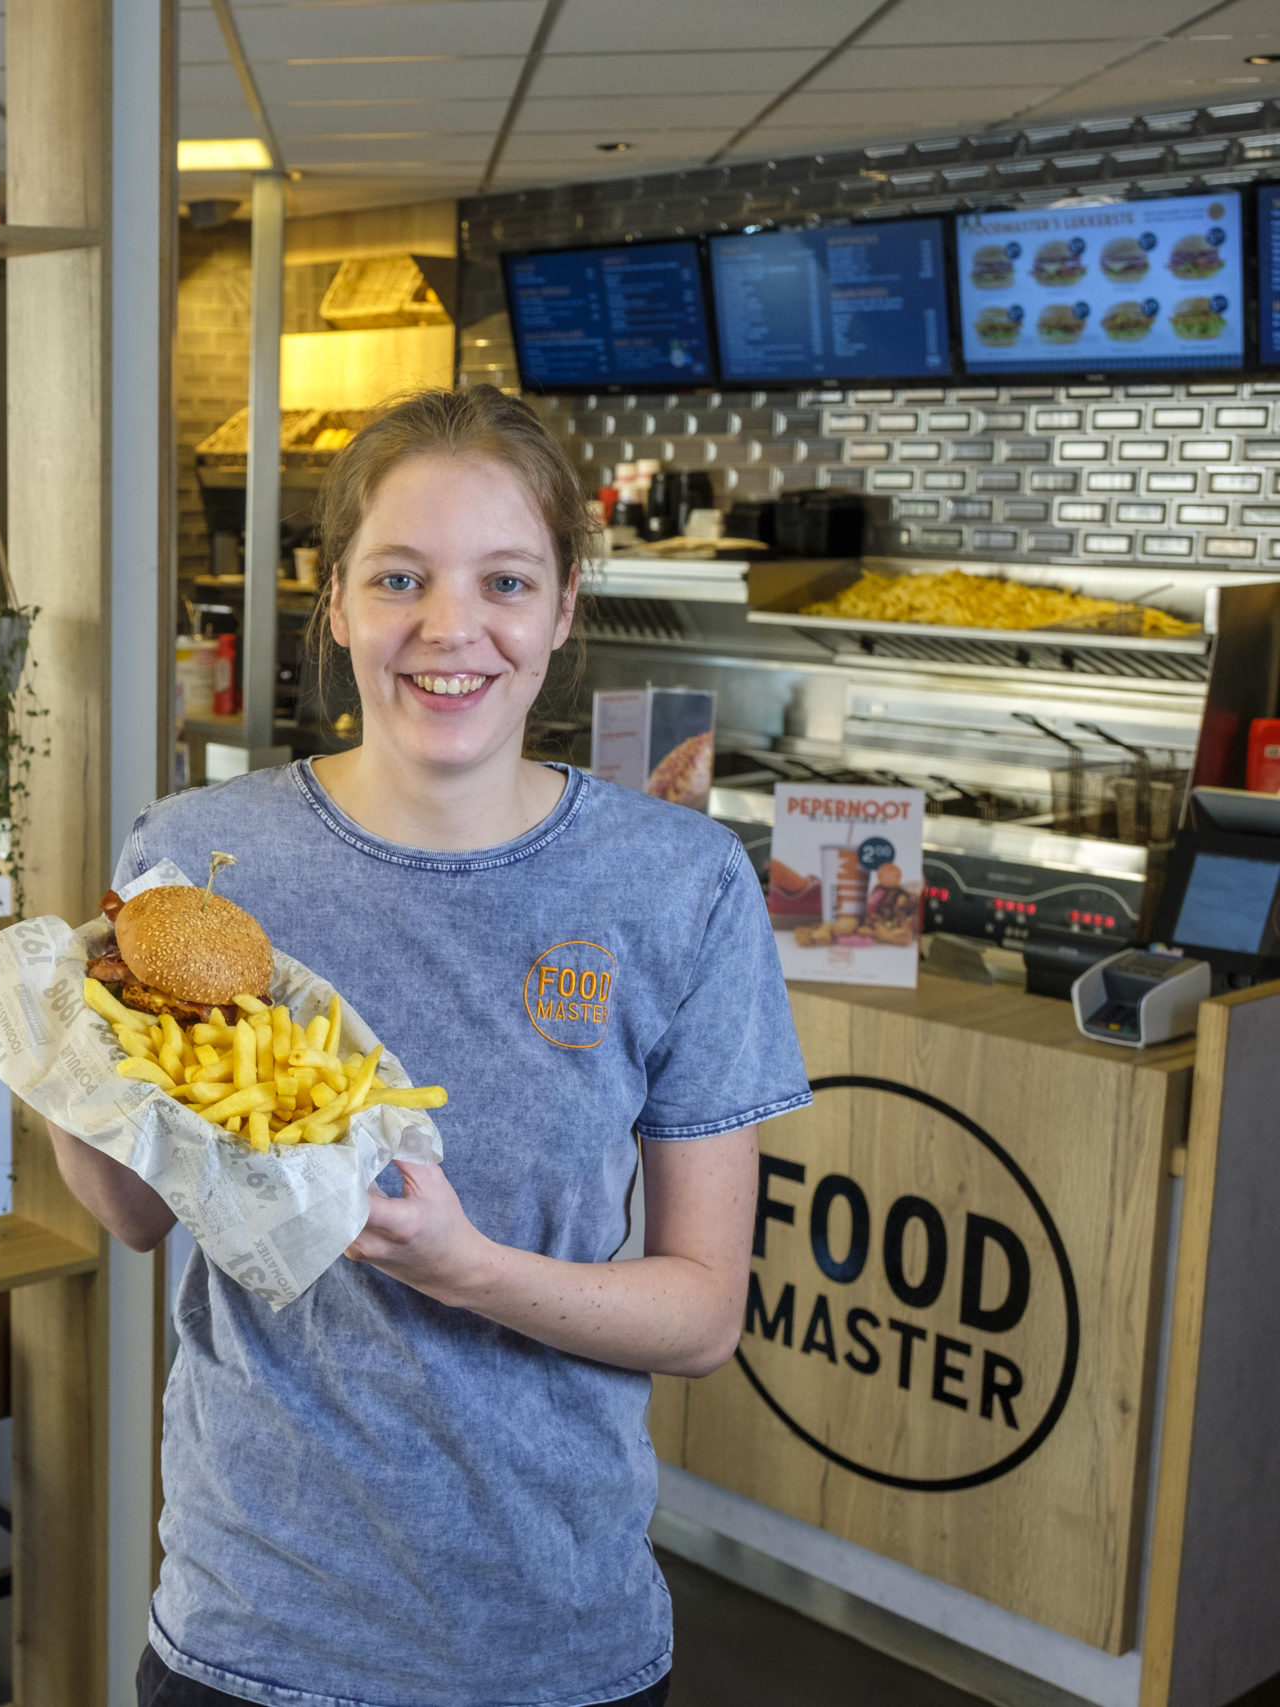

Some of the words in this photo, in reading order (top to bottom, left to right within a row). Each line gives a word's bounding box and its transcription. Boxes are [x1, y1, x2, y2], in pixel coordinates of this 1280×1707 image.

[787, 796, 911, 820] PEPERNOOT
[15, 919, 54, 966] 192
[43, 978, 85, 1029] 1998
[538, 965, 611, 1002] FOOD
[536, 998, 608, 1024] MASTER
[254, 1238, 297, 1299] UTOMATIEK
[751, 1153, 1031, 1334] FOOD
[226, 1251, 278, 1303] 931
[745, 1271, 1025, 1431] MASTER
